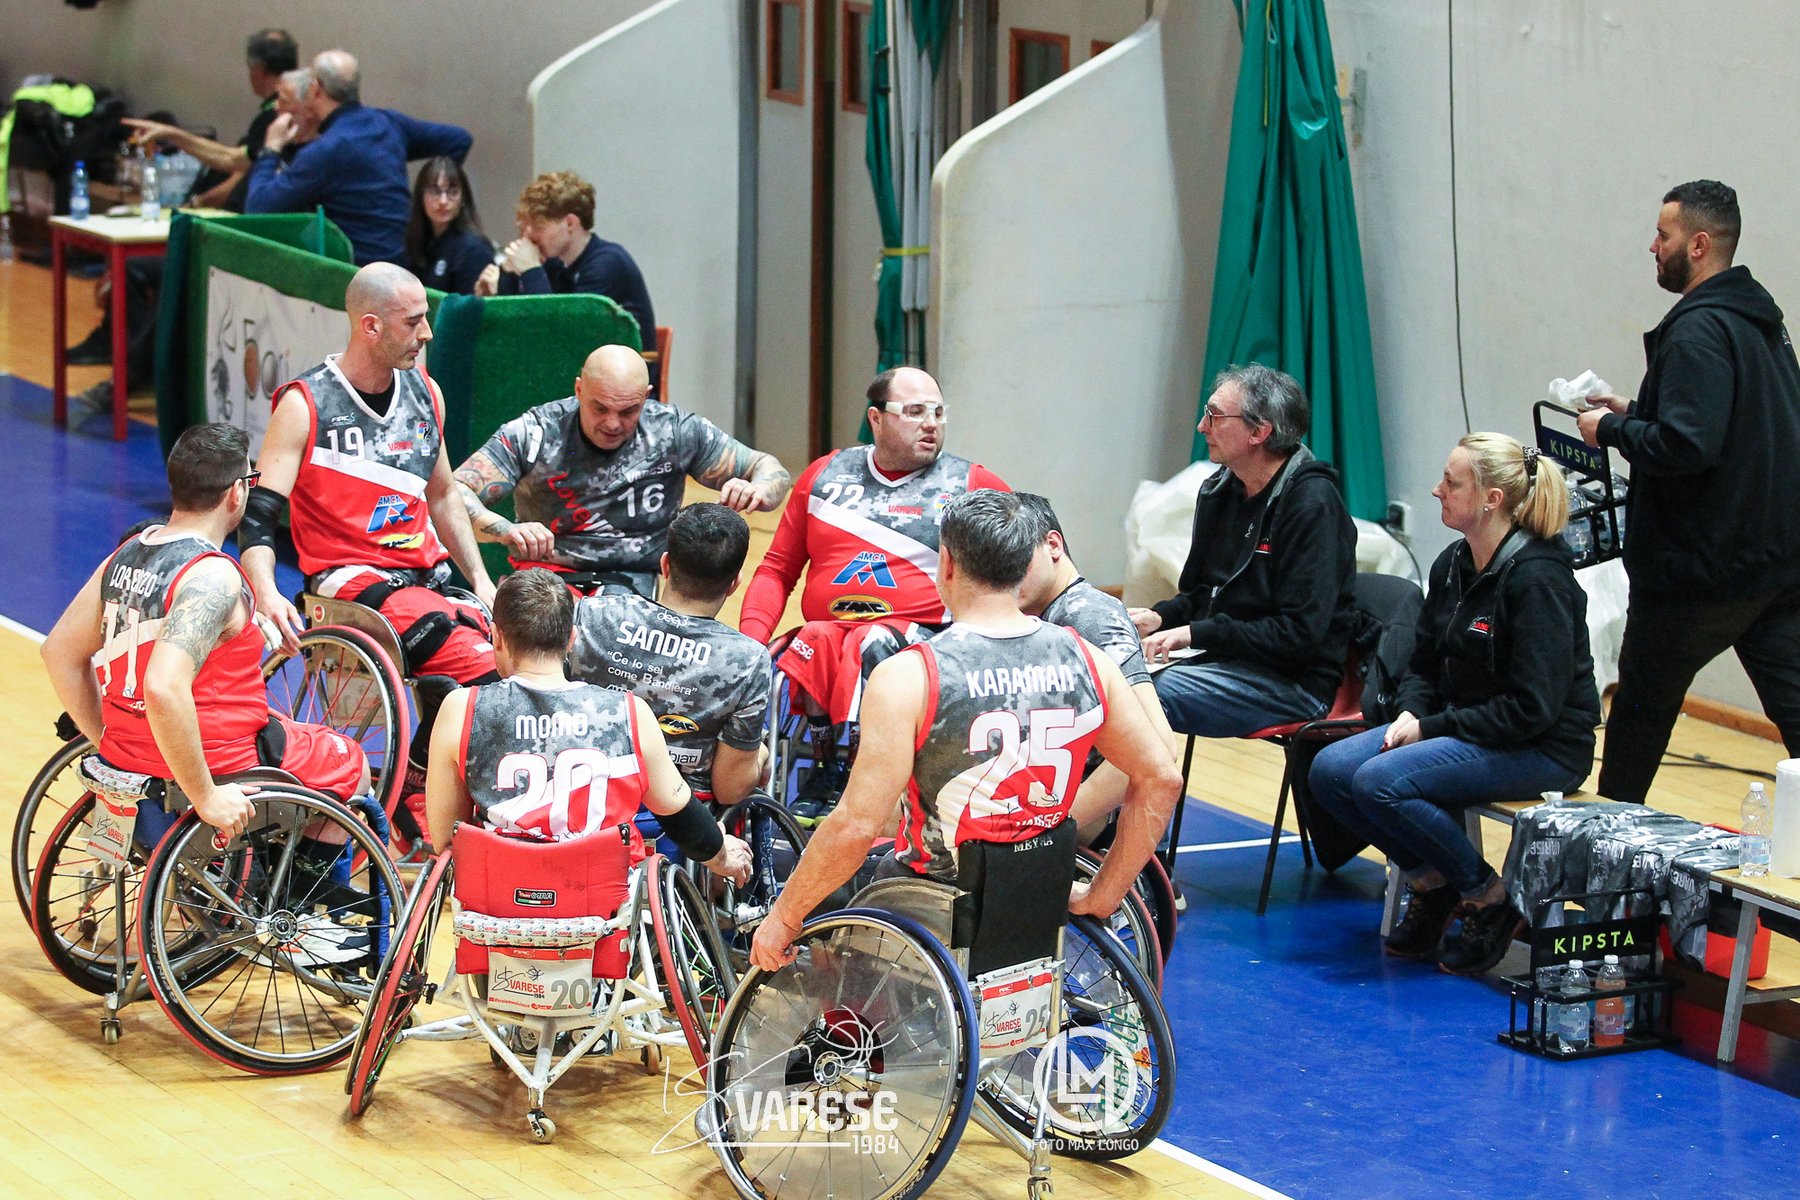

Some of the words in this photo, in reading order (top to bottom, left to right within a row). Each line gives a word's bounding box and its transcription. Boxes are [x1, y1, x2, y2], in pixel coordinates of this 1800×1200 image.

[327, 427, 366, 465] 19
[1550, 439, 1597, 470] KIPSTA
[617, 483, 665, 518] 16
[819, 483, 865, 514] 22
[857, 552, 886, 561] AMCA
[607, 666, 638, 682] come
[632, 657, 643, 670] lo
[647, 663, 664, 675] sei
[965, 664, 1075, 699] KARAMAN
[969, 708, 1076, 819] 25
[497, 748, 610, 836] 20
[1554, 930, 1635, 955] KIPSTA
[509, 979, 545, 994] VARESE
[550, 978, 590, 1010] 20
[996, 1017, 1021, 1033] VARESE
[1024, 1003, 1048, 1042] 25
